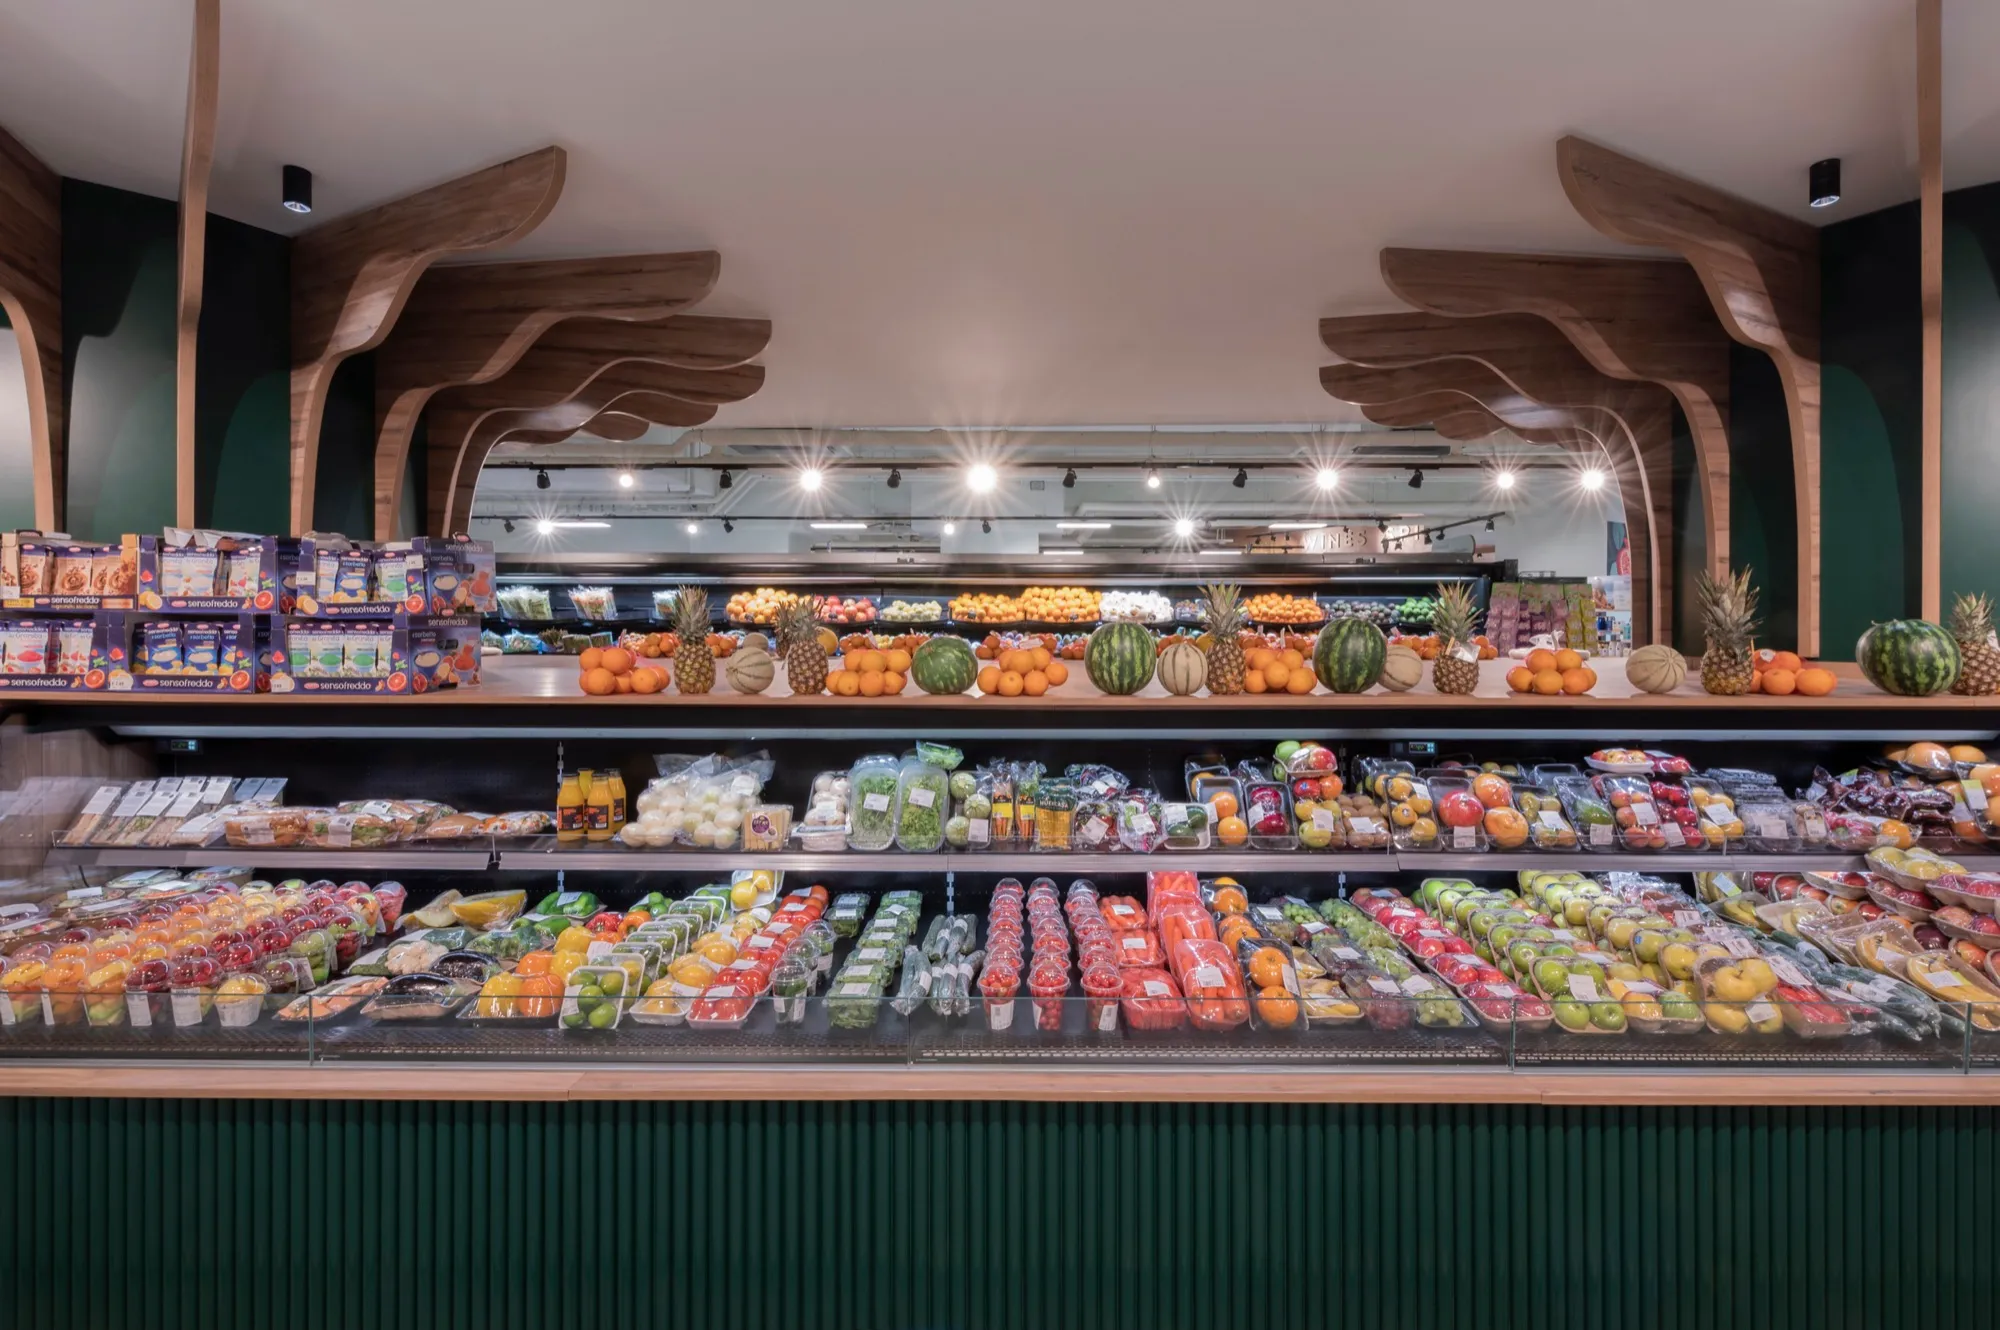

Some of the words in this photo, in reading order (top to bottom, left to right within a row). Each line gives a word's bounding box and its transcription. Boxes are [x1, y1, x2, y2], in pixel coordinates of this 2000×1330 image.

[1303, 529, 1367, 550] WINES
[51, 596, 100, 604] sensofreddo
[187, 599, 239, 609] sensofreddo
[340, 605, 391, 614] sensofreddo
[428, 617, 468, 627] sensofreddo
[11, 678, 67, 687] sensofreddo
[159, 679, 213, 688] sensofreddo
[320, 681, 371, 690] sensofreddo
